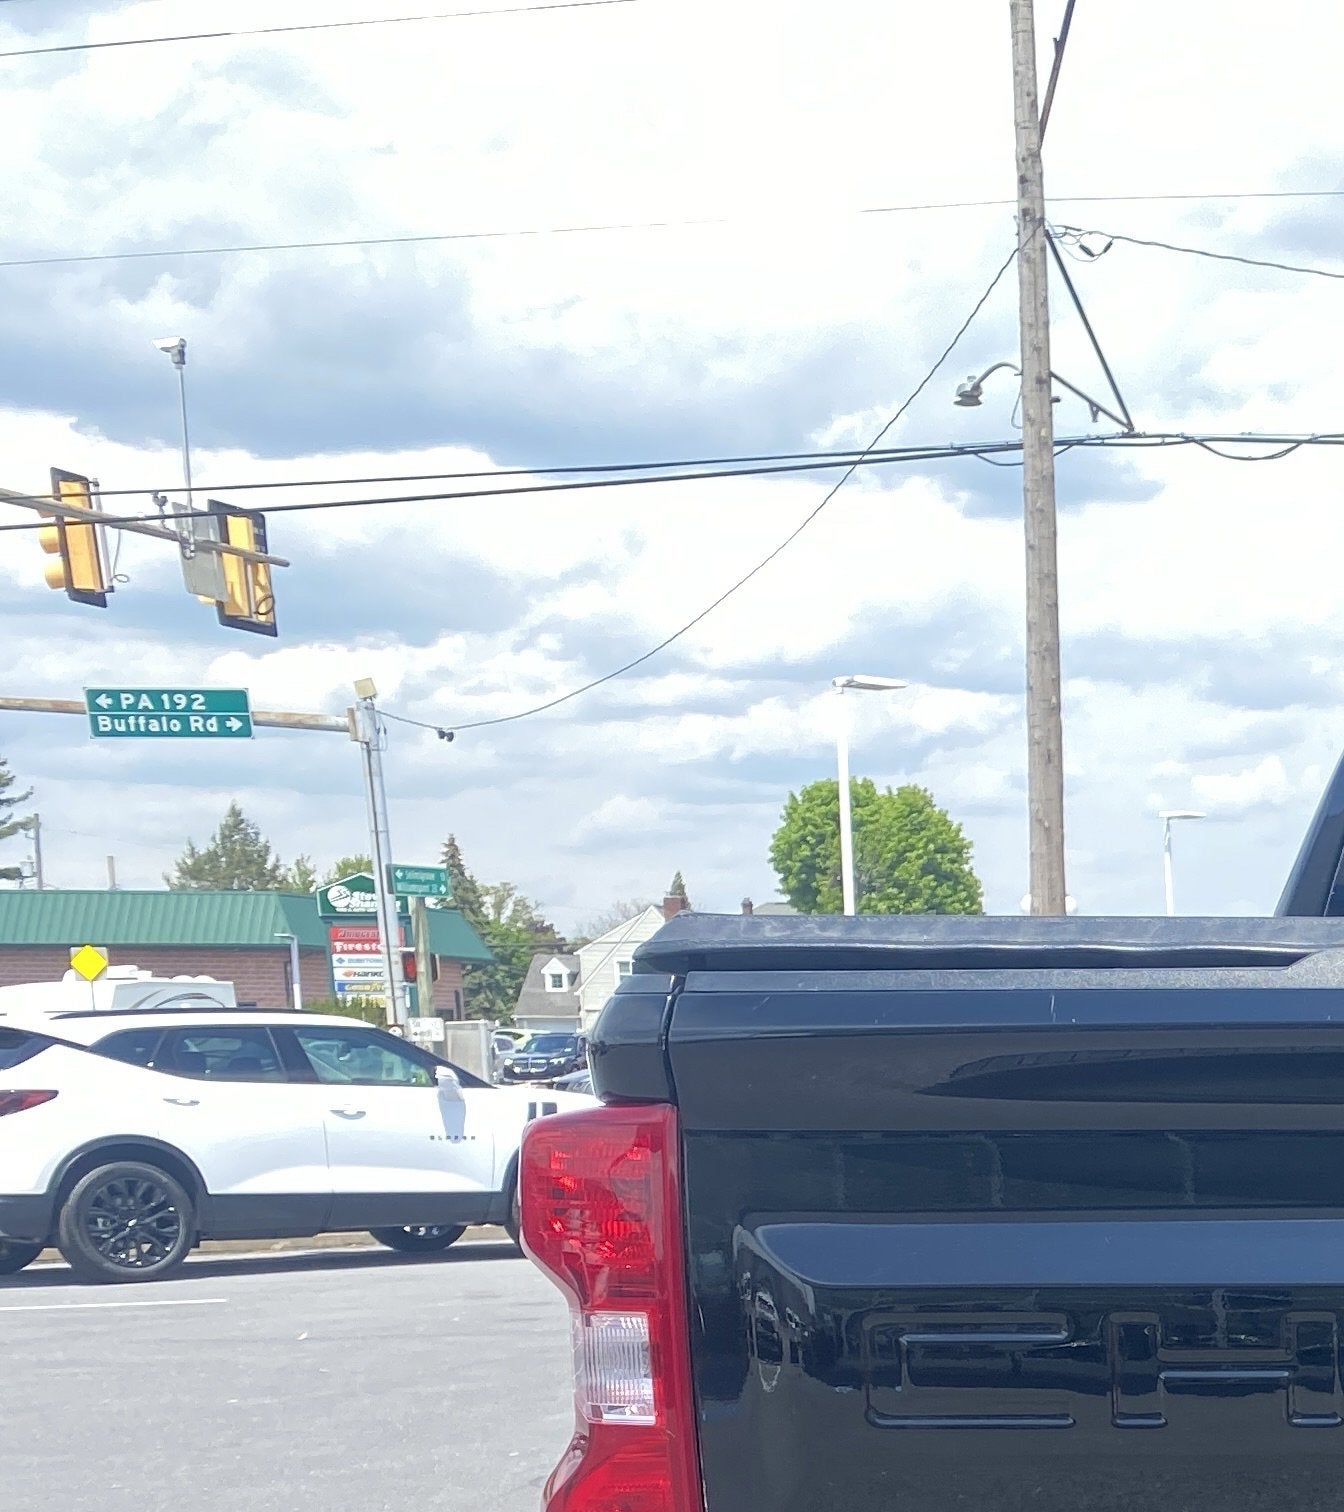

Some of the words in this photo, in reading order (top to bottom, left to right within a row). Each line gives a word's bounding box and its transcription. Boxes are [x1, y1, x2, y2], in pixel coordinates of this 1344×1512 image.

[120, 693, 154, 710] PA
[161, 693, 206, 710] 192
[97, 715, 181, 732] Buffalo
[189, 716, 217, 732] Rd
